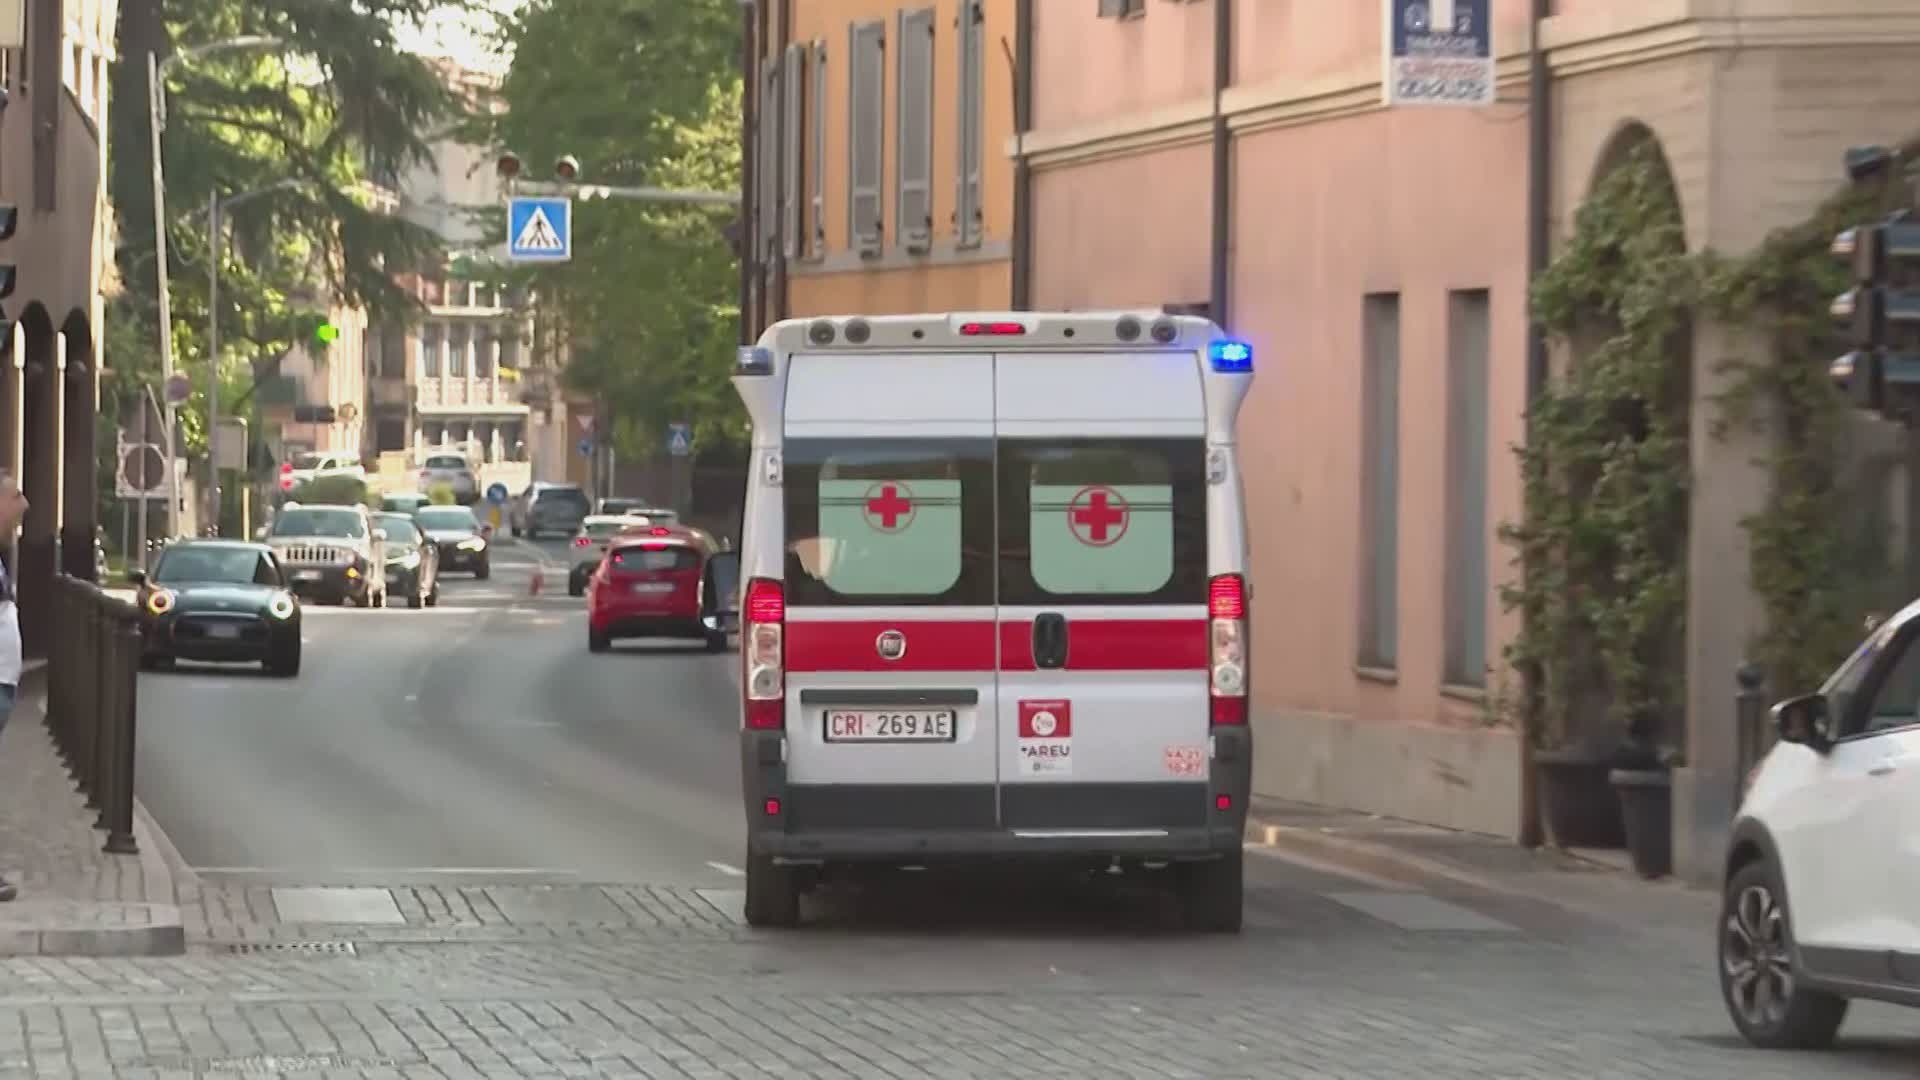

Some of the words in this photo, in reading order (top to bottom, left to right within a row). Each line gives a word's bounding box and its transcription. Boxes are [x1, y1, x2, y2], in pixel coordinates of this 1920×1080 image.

[832, 713, 863, 736] CRI
[877, 714, 917, 736] 269
[923, 713, 948, 736] AE
[1027, 745, 1071, 757] AREU
